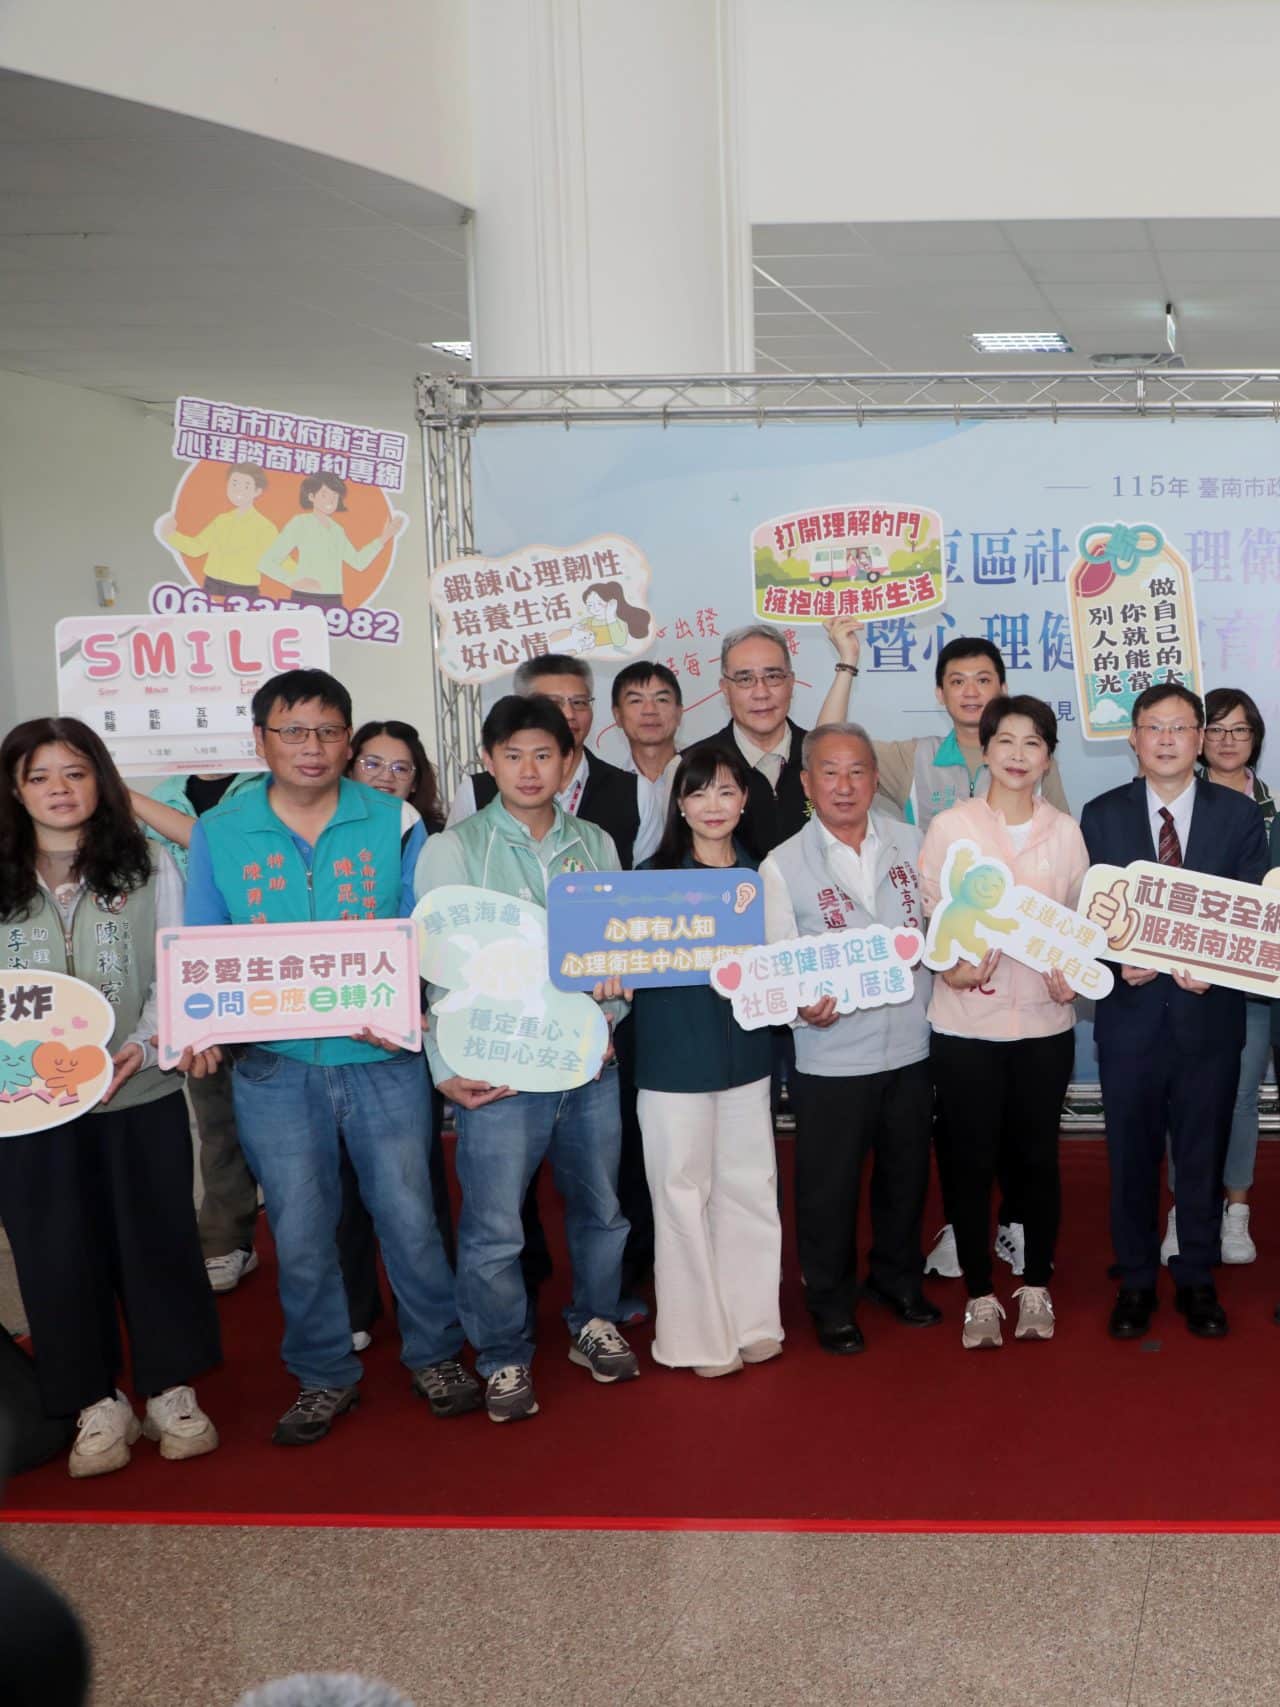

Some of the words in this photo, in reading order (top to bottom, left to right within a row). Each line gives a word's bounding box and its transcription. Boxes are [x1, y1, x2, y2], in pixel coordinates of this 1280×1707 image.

[180, 399, 405, 461] 臺南市政府衛生局
[177, 430, 401, 490] 心理諮商預約專線
[1112, 475, 1190, 498] 115年
[774, 510, 921, 550] 打開理解的門
[443, 549, 624, 604] 鍛鍊心理韌性
[764, 572, 936, 616] 擁抱健康新生活
[452, 592, 572, 637] 培養生活
[84, 628, 301, 678] SMILE
[460, 632, 550, 672] 好心情
[1088, 606, 1123, 696] 別人的光
[1119, 603, 1153, 693] 你就能當
[149, 709, 161, 730] 能動
[196, 707, 208, 728] 互動
[422, 900, 521, 936] 學習海龜
[604, 915, 716, 942] 心事有人知
[1016, 895, 1097, 949] 走進心理
[181, 950, 398, 985] 珍愛生命守門人
[751, 934, 889, 981] 心理健康促進
[1025, 935, 1103, 990] 看見自己
[0, 985, 53, 1022] 炸
[183, 981, 396, 1020] 一問二應三轉介
[463, 1036, 583, 1073] 找回心安全
